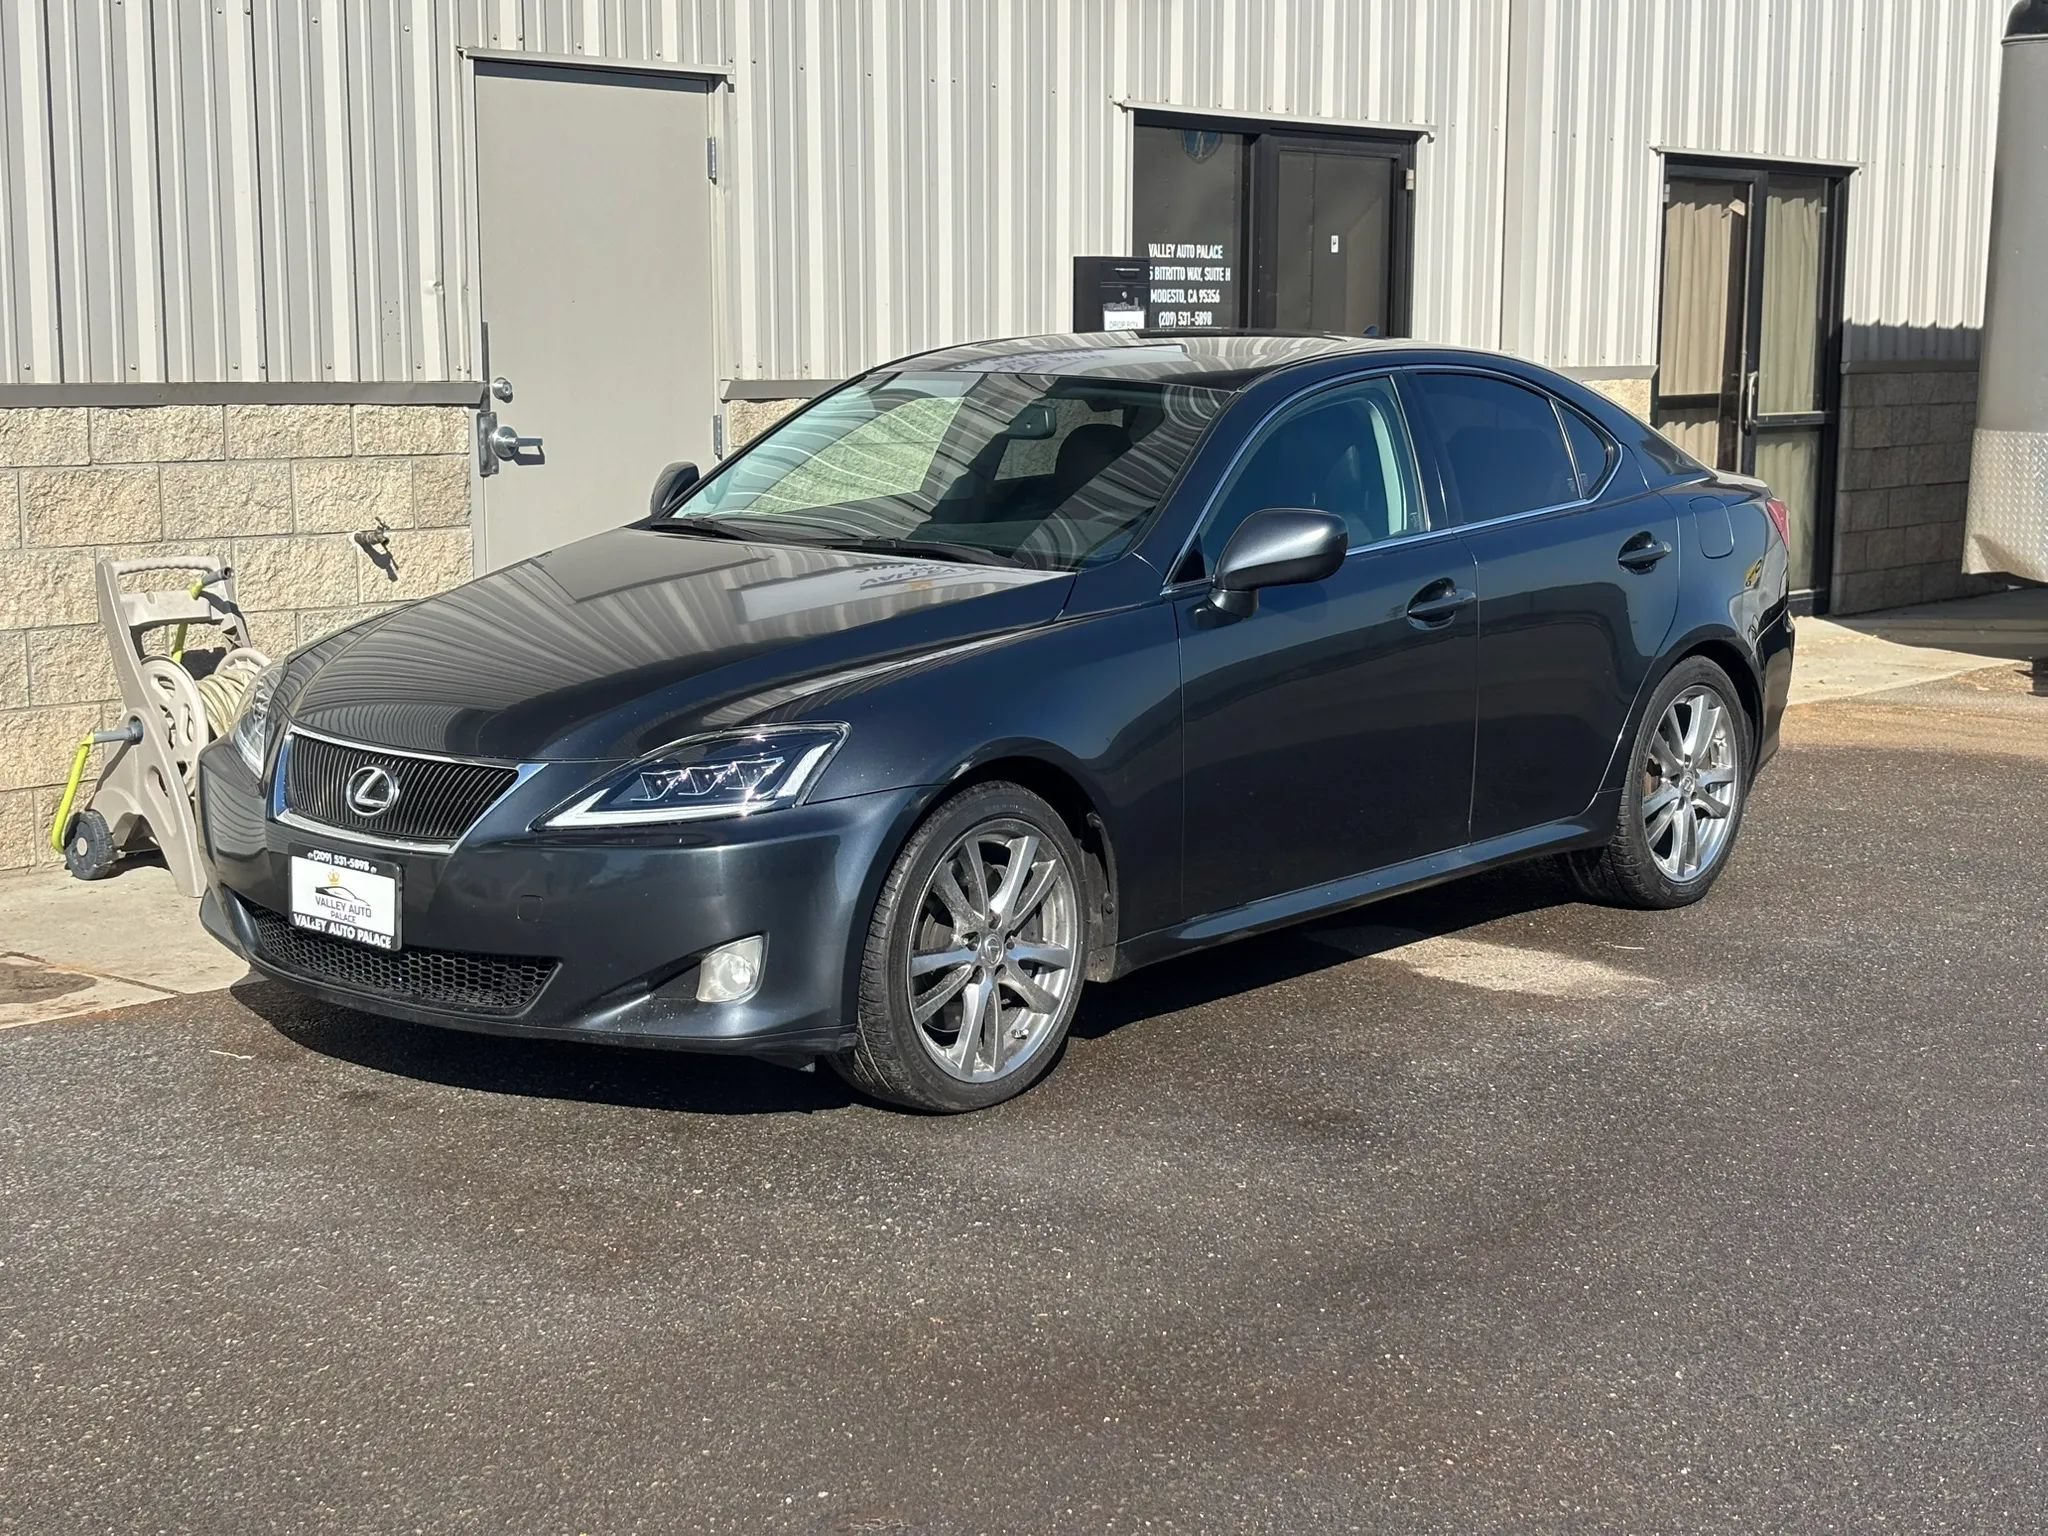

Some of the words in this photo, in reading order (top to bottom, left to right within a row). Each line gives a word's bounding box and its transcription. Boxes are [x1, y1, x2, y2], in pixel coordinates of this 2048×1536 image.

[1148, 243, 1176, 258] VALLEY
[1176, 244, 1195, 258] AUTO
[1196, 244, 1223, 259] PALACE
[1154, 266, 1185, 281] BITRITTO
[1187, 267, 1203, 282] WAY,
[1204, 267, 1224, 281] SUITE
[1225, 268, 1231, 281] H
[1187, 289, 1198, 303] CA
[1199, 289, 1220, 303] 95356
[1158, 311, 1177, 328] (209)
[313, 850, 332, 864] (209)
[334, 854, 370, 871] 531-5898
[315, 896, 346, 911] VALLEY
[349, 905, 372, 917] AUTO
[330, 911, 356, 923] PALACE
[293, 913, 327, 932] VALLEY
[328, 923, 356, 939] AUTO
[357, 929, 392, 949] PALACE
